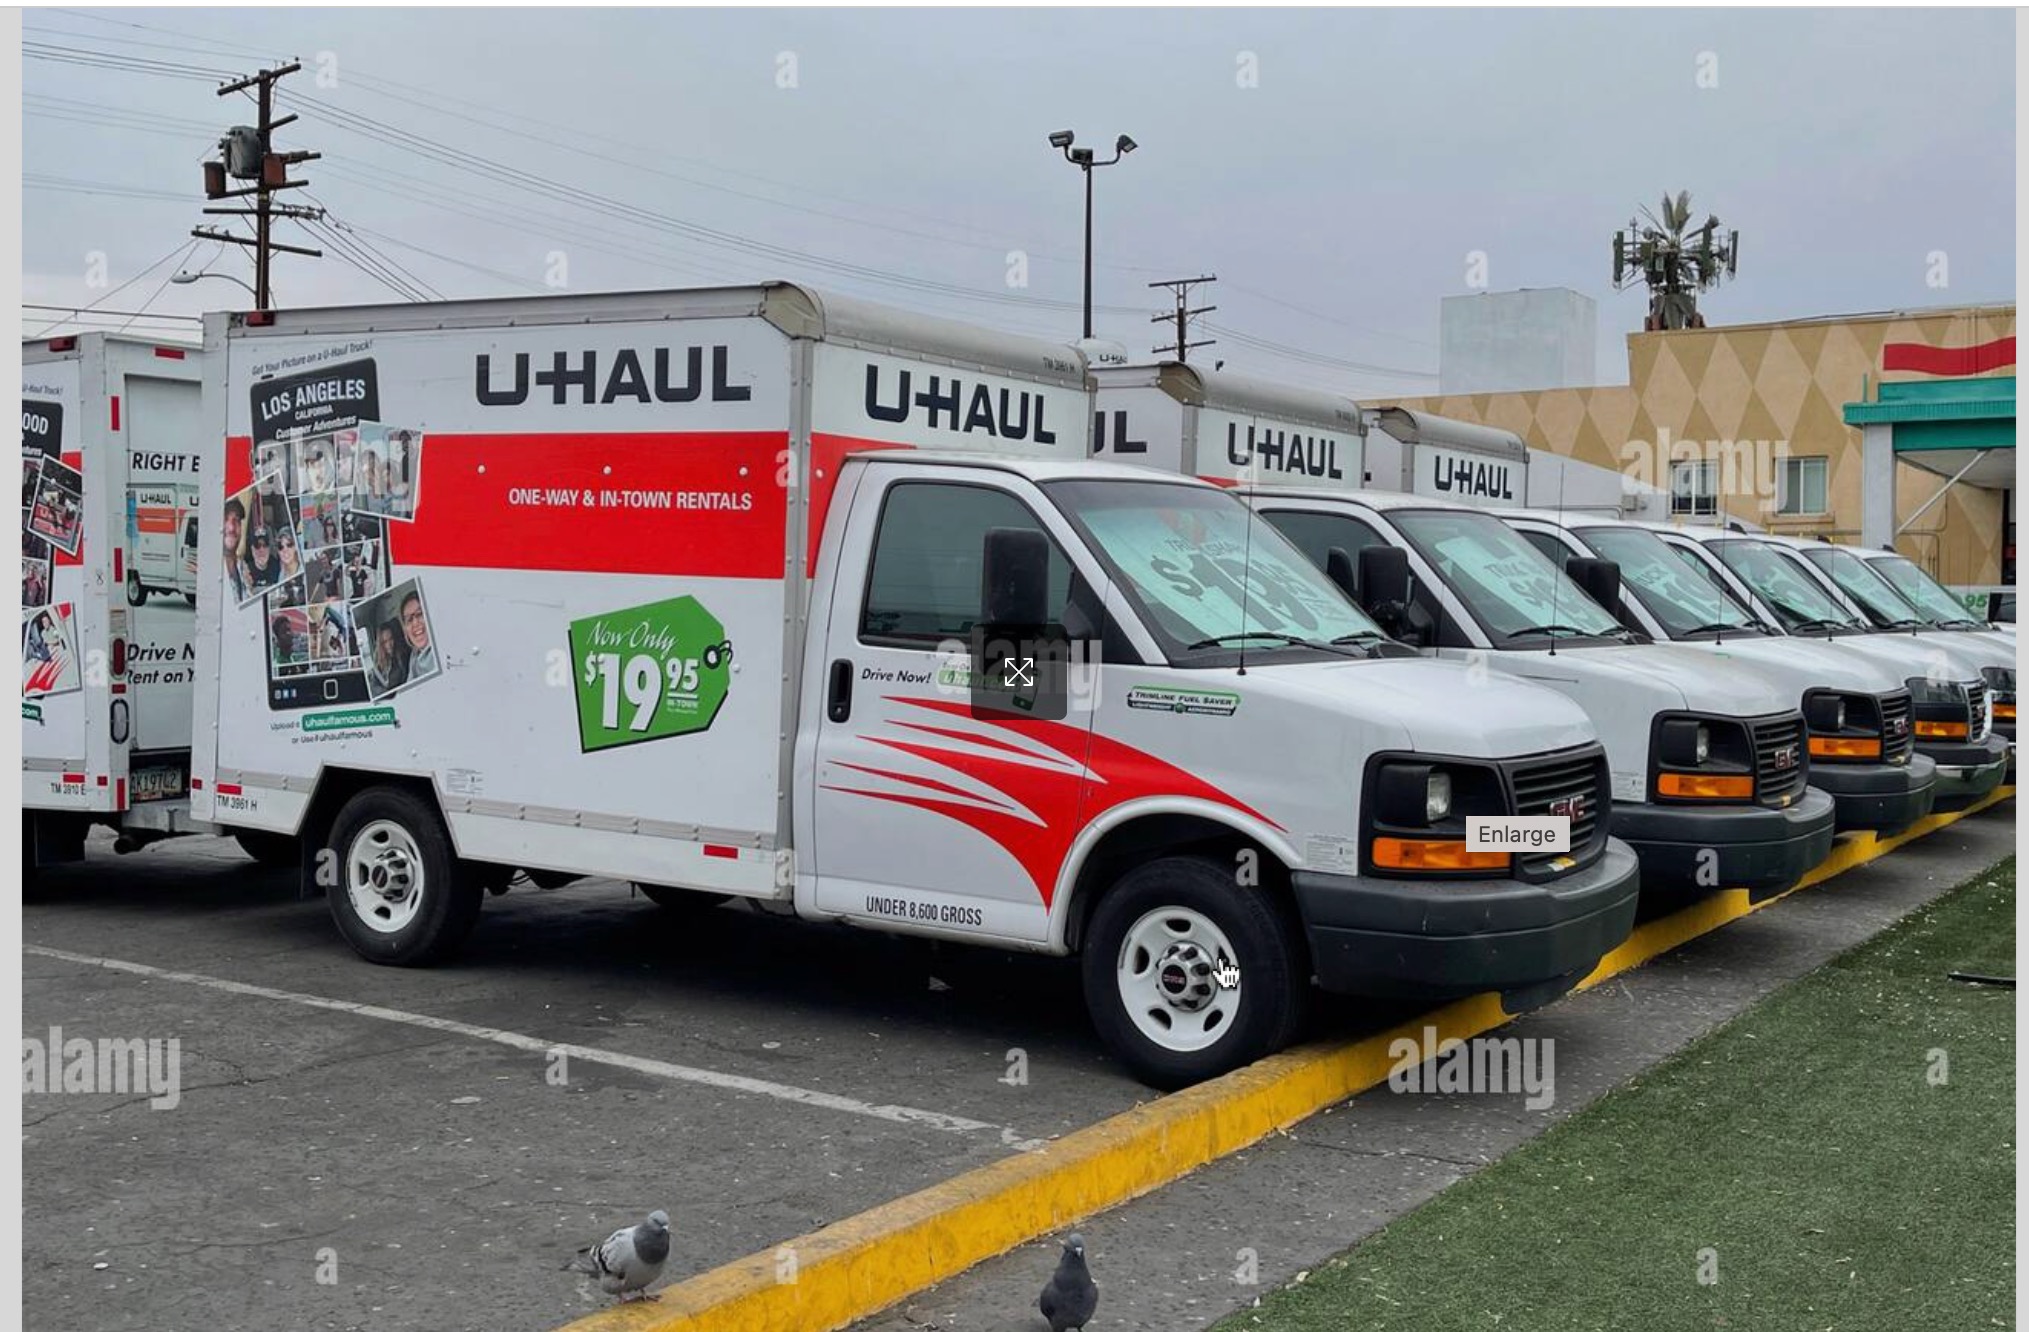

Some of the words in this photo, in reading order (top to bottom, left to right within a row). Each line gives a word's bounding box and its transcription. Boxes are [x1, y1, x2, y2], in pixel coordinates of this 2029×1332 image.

[265, 361, 280, 373] Your
[323, 343, 349, 360] U-Haul
[349, 340, 373, 354] Truck!
[476, 346, 751, 406] U-HAUL
[261, 391, 292, 421] LOS
[295, 379, 366, 408] ANGELES
[866, 364, 1056, 445] U-HAUL
[22, 412, 49, 436] OOD
[294, 404, 334, 421] CALIFORNIA
[275, 424, 313, 440] Customer
[313, 415, 357, 432] Adventures
[132, 452, 186, 472] RIGHT
[1228, 421, 1342, 480] U-HAUL
[1434, 455, 1512, 499] U-HAUL
[509, 488, 579, 507] ONE-WAY
[582, 489, 595, 508] &
[600, 490, 672, 509] IN-TOWN
[676, 491, 752, 510] RENTALS
[127, 641, 177, 661] Drive
[587, 620, 625, 646] Now
[629, 620, 679, 661] Only
[163, 671, 184, 684] on
[861, 668, 893, 682] Drive
[896, 670, 932, 684] Now!
[1135, 691, 1175, 702] TRIMLINE
[1178, 694, 1200, 704] FUEL
[1202, 696, 1233, 706] SAVER
[304, 711, 391, 729] uhaulfamous.com
[51, 783, 63, 794] TM
[217, 795, 229, 807] TM
[231, 798, 249, 810] 3961
[251, 800, 258, 811] H
[866, 895, 907, 917] UNDER
[909, 901, 939, 921] 8,600
[940, 904, 983, 926] GROSS
